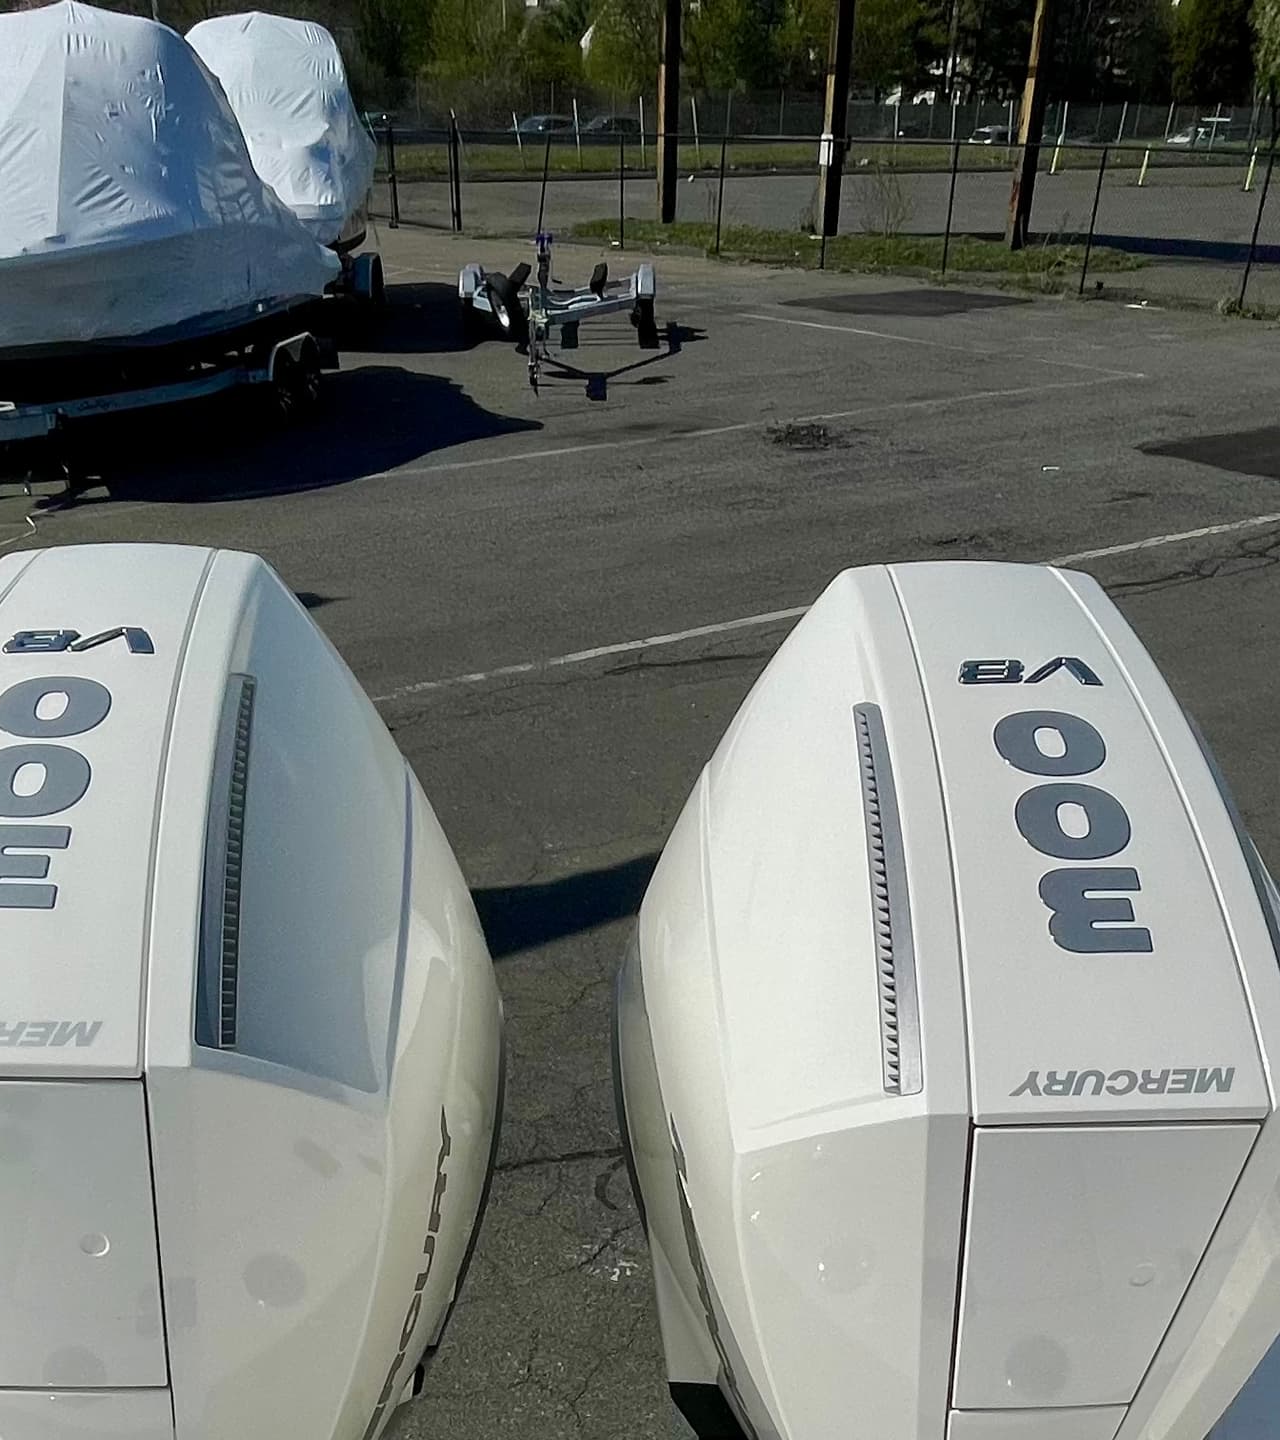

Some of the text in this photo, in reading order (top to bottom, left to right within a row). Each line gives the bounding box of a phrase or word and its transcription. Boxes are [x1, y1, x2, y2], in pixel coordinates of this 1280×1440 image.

[2, 627, 154, 654] V8
[959, 657, 1104, 686] V8
[993, 710, 1154, 953] 300
[1008, 1067, 1235, 1097] MERCURY
